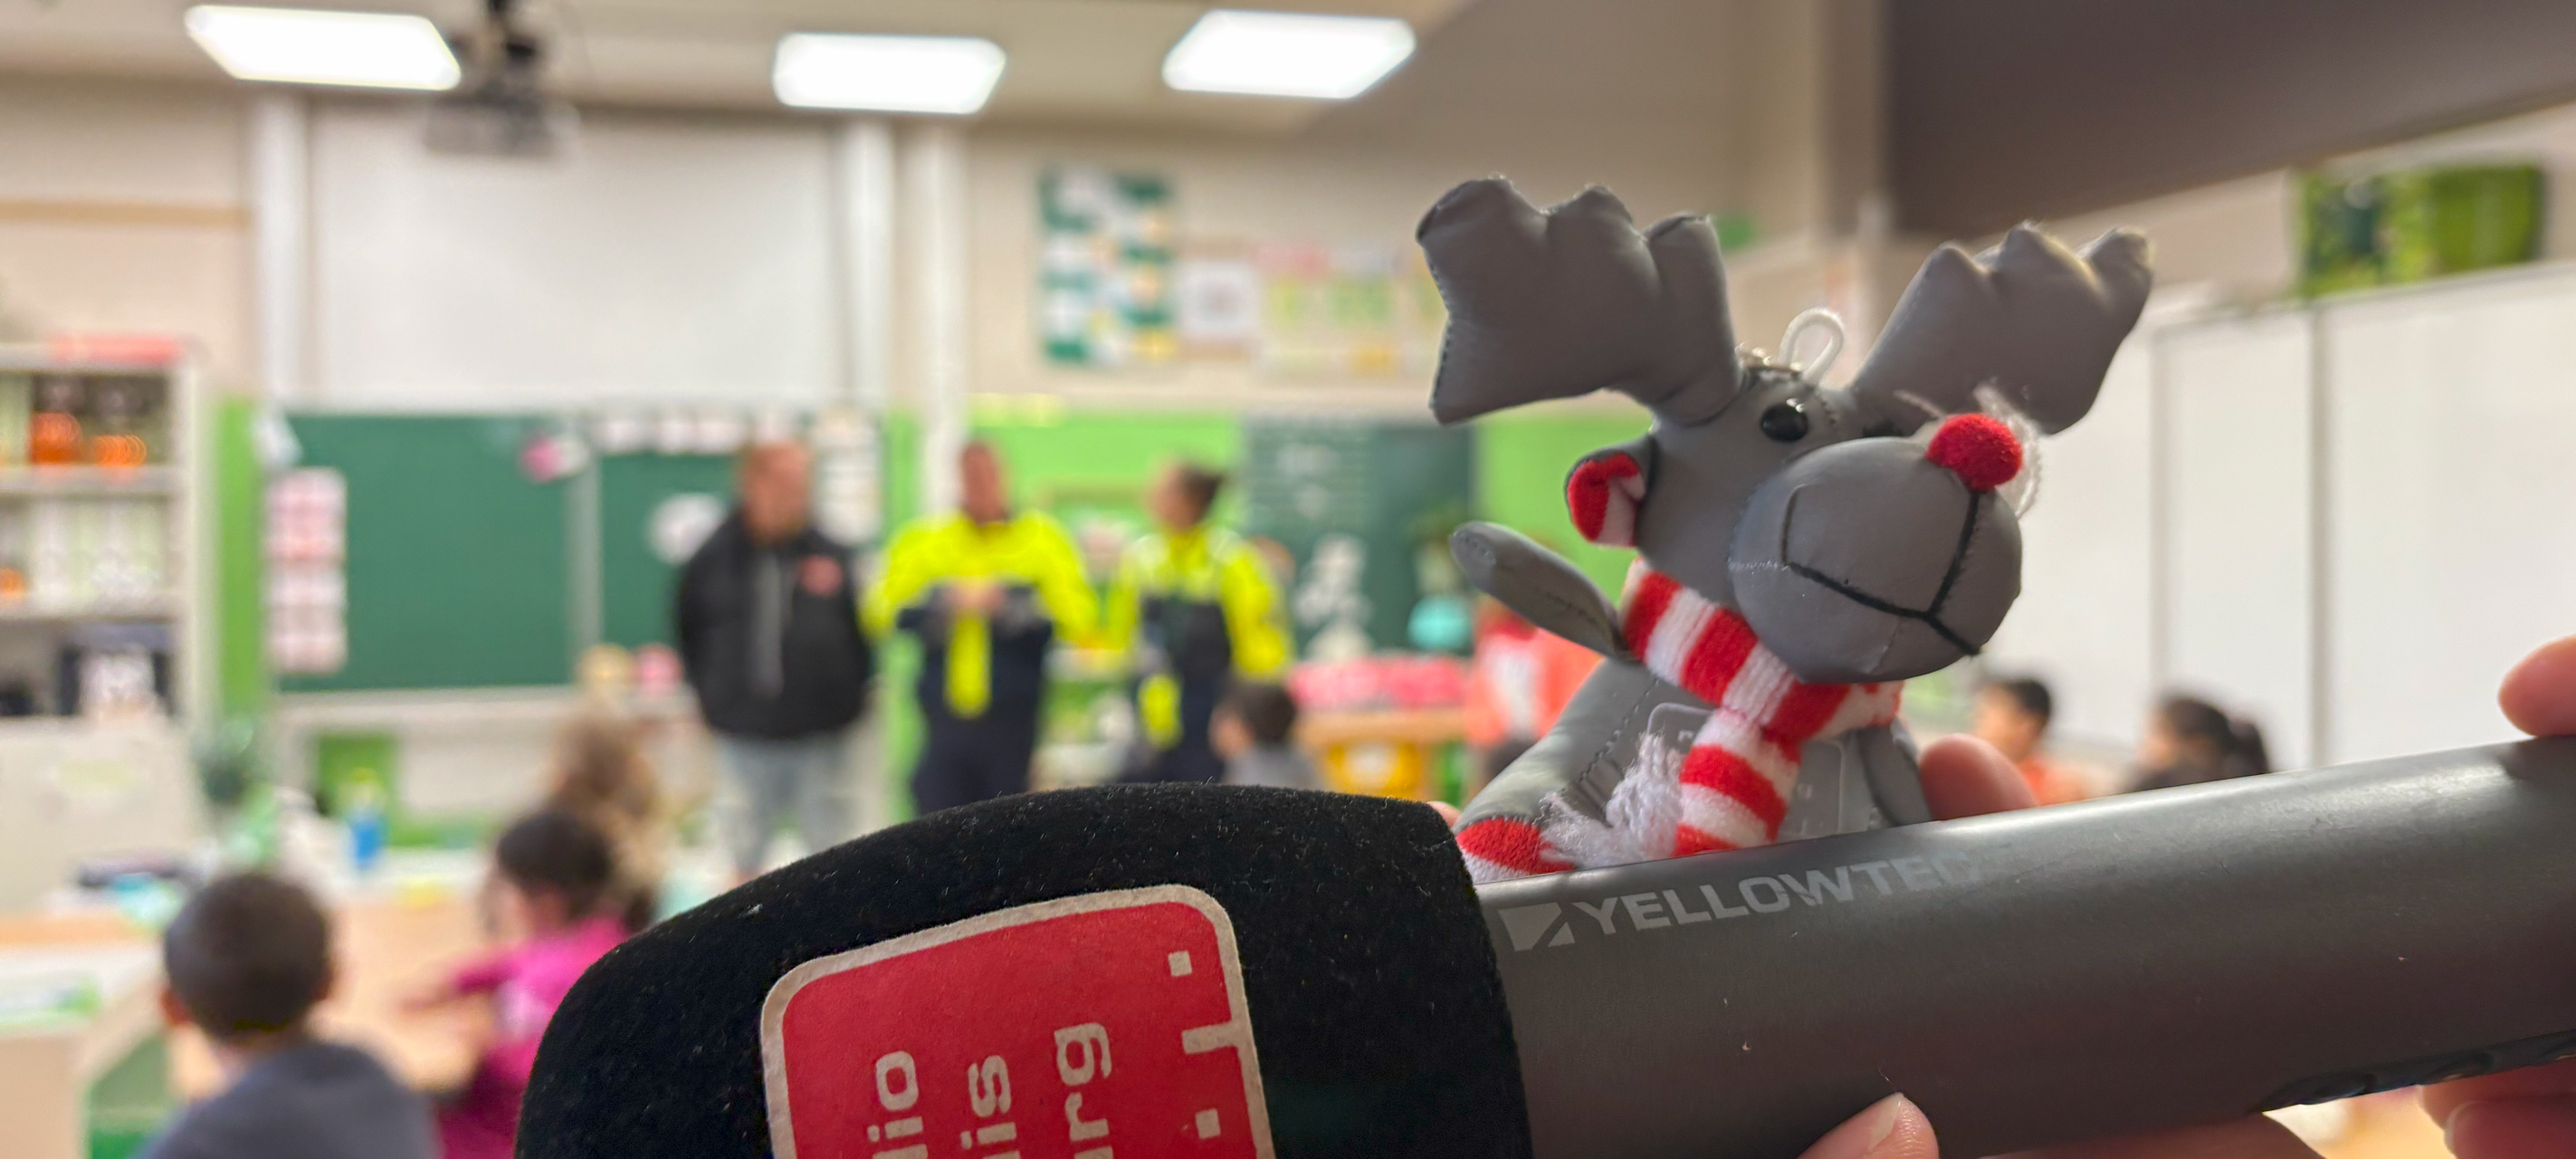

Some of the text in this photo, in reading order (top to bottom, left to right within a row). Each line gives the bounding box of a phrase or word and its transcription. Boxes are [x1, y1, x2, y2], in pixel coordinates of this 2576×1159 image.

[867, 1050, 929, 1159] io
[960, 1055, 1021, 1159] is
[1054, 1022, 1113, 1159] rg
